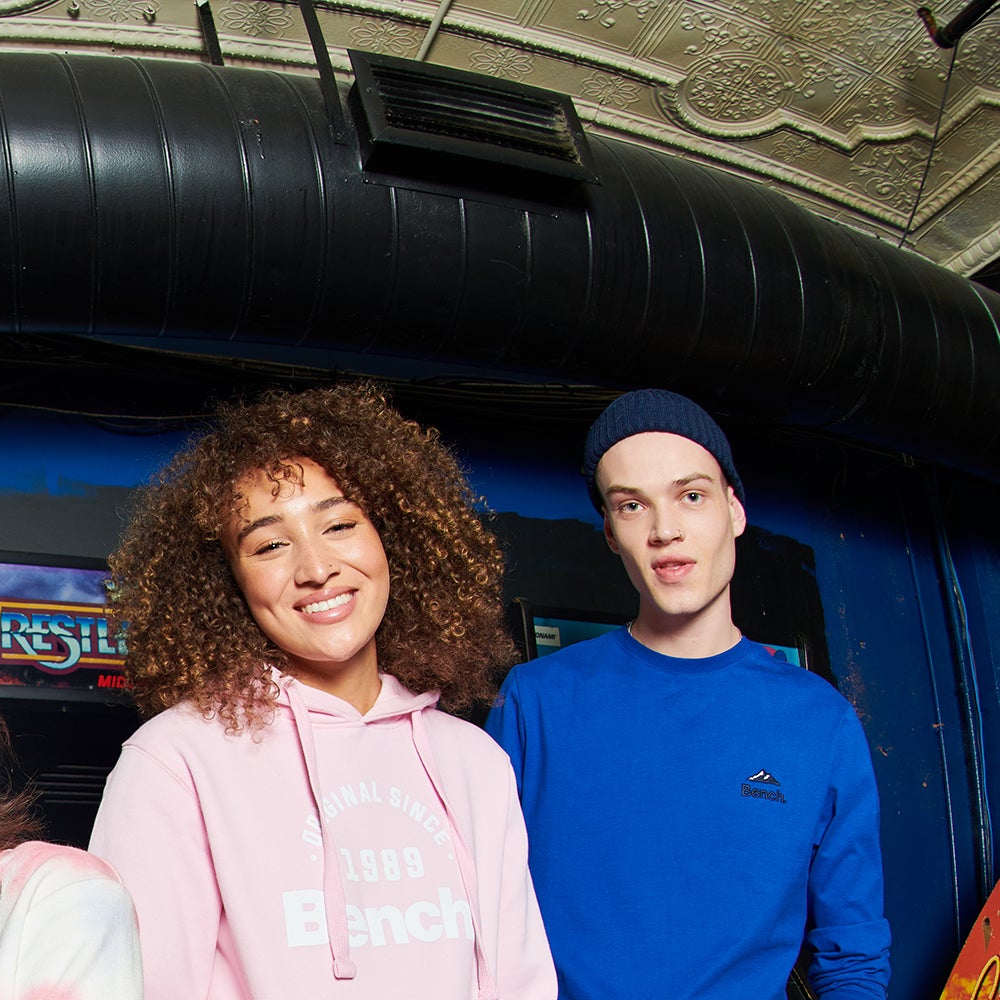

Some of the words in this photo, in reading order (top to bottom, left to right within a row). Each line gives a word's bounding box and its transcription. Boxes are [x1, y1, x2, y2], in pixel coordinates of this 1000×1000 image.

[97, 673, 133, 689] MID
[741, 783, 787, 804] Bench.
[388, 785, 450, 846] SINCE
[340, 846, 425, 883] 1989
